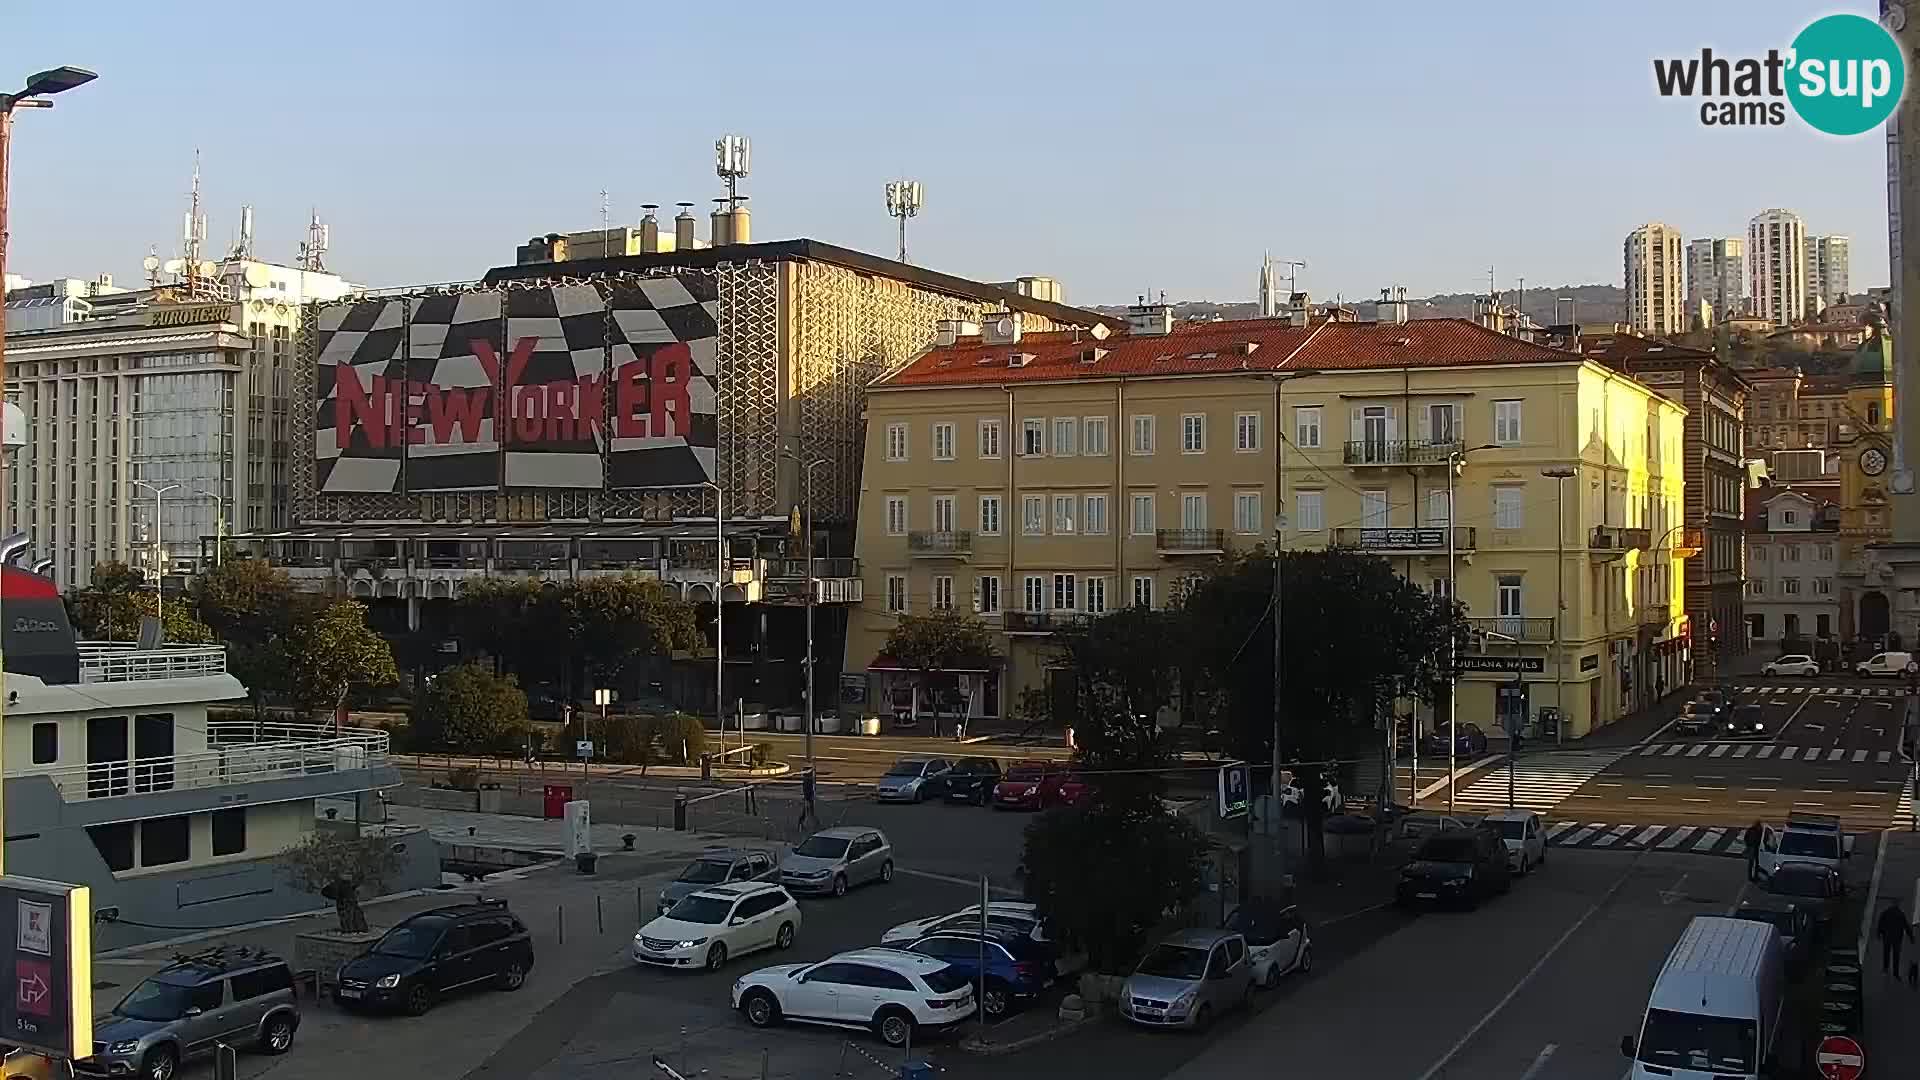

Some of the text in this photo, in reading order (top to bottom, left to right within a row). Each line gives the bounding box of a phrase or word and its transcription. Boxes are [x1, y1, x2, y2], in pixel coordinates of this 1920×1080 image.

[1457, 660, 1538, 669] JULIANA NAILS
[17, 1018, 37, 1032] 5 km
